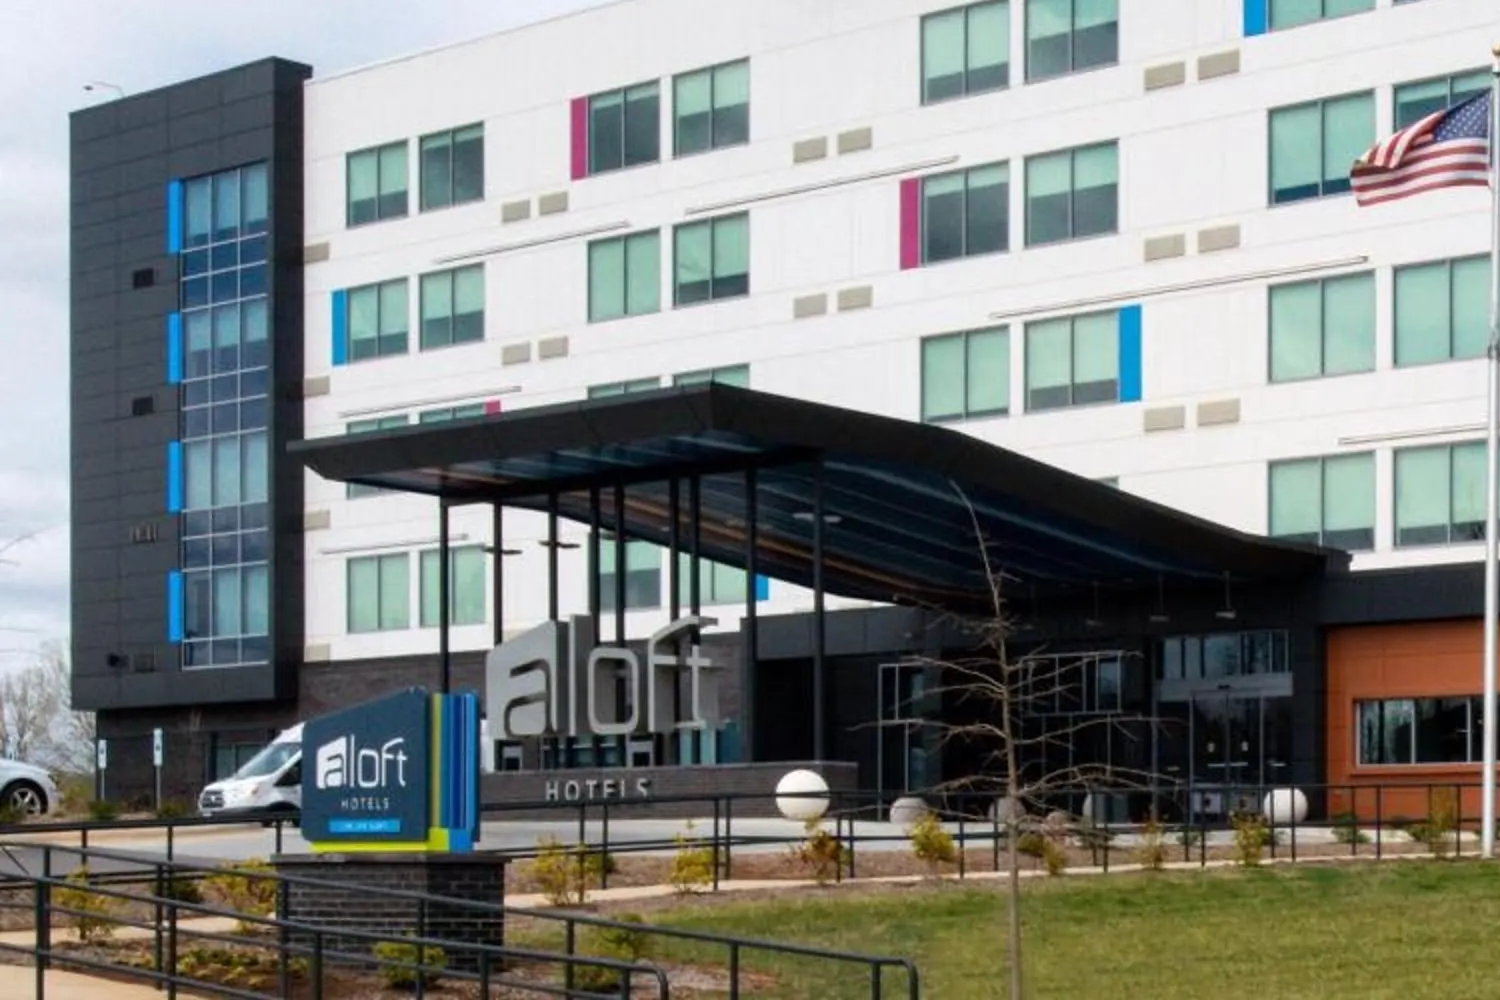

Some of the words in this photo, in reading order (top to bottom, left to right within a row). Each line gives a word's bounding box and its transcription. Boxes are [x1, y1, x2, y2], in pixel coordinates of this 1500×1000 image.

[486, 614, 718, 740] aloft
[316, 733, 407, 790] aloft
[341, 797, 390, 811] HOTELS
